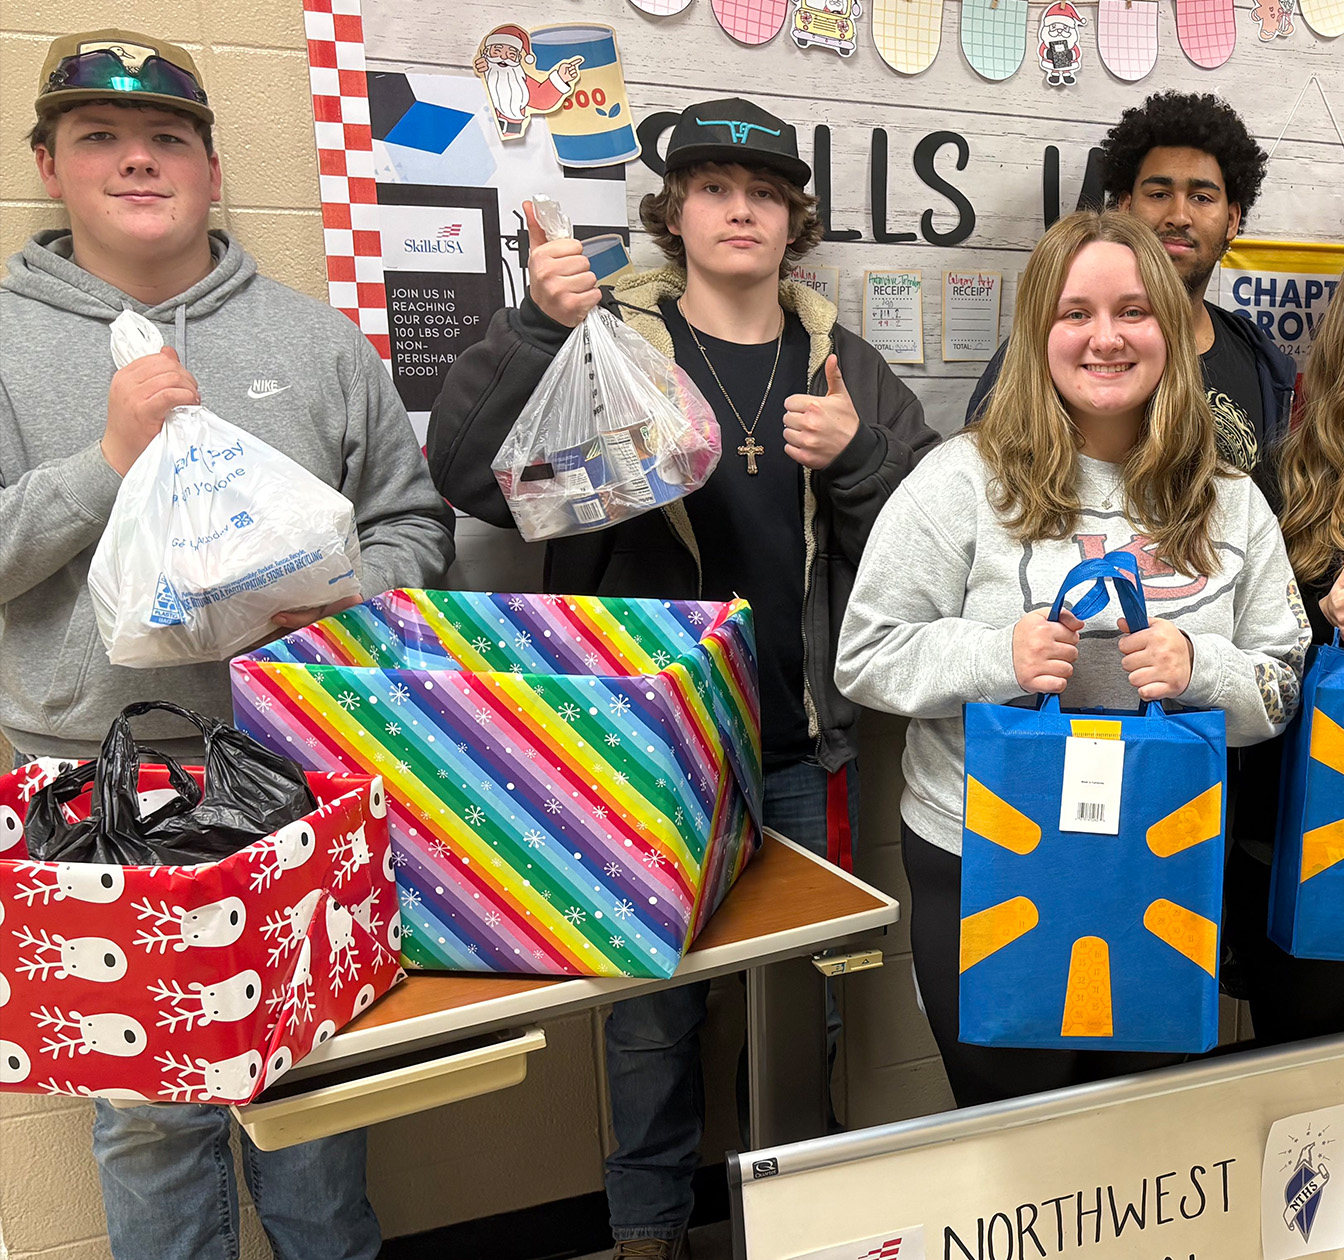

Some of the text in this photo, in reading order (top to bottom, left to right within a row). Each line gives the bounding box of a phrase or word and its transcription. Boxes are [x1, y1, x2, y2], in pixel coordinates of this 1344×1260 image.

[404, 239, 464, 254] SkillsUSA
[392, 289, 455, 299] JOIN US IN
[874, 286, 911, 295] RECEIPT
[953, 286, 992, 296] RECEIPT
[392, 302, 455, 312] REACHING
[393, 315, 479, 325] OUR GOAL OF
[395, 328, 461, 338] 100 LBS OF
[396, 341, 428, 350] NON-
[399, 366, 438, 376] FOOD!
[252, 379, 278, 391] NIKE
[1290, 1181, 1318, 1212] NTHS
[944, 1158, 1238, 1260] NORTHWEST
